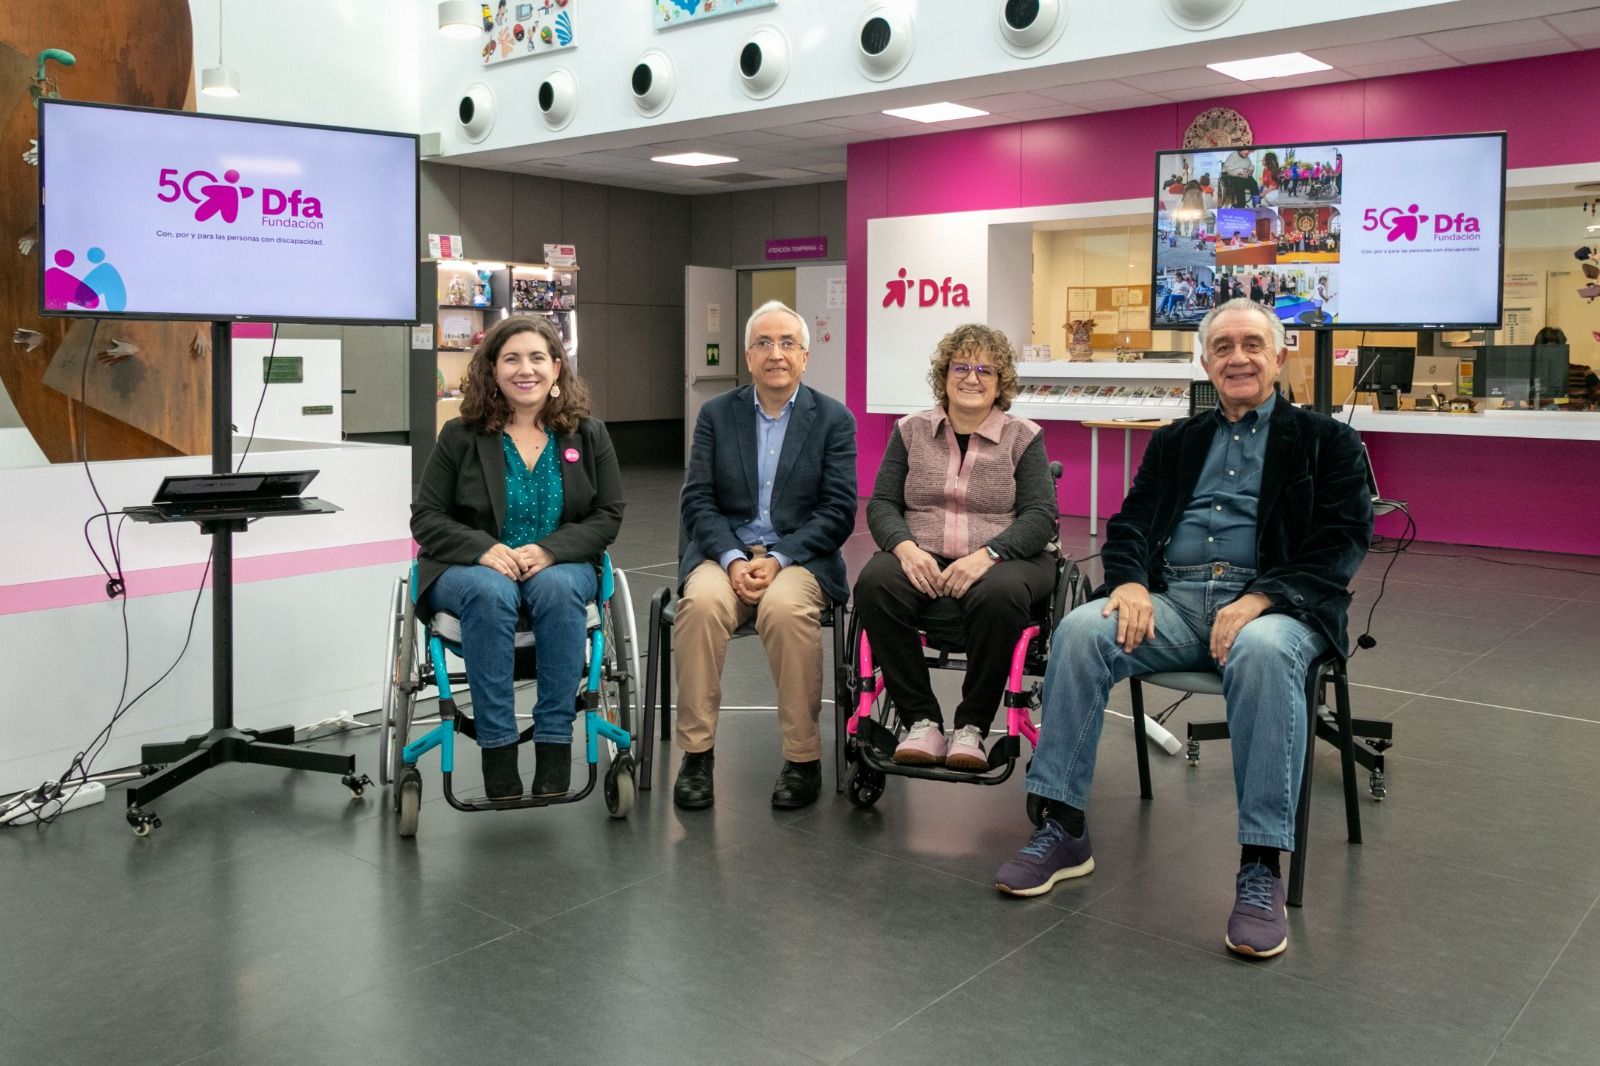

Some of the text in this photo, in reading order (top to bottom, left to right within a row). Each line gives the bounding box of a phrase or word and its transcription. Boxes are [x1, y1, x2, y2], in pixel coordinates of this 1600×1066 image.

[262, 188, 323, 218] Dfa
[262, 217, 324, 229] Fundación
[1434, 213, 1480, 233] Dfa
[156, 230, 174, 238] Con,
[197, 233, 214, 241] para
[215, 233, 226, 241] las
[1433, 233, 1480, 241] Fundación
[919, 276, 970, 307] Dfa
